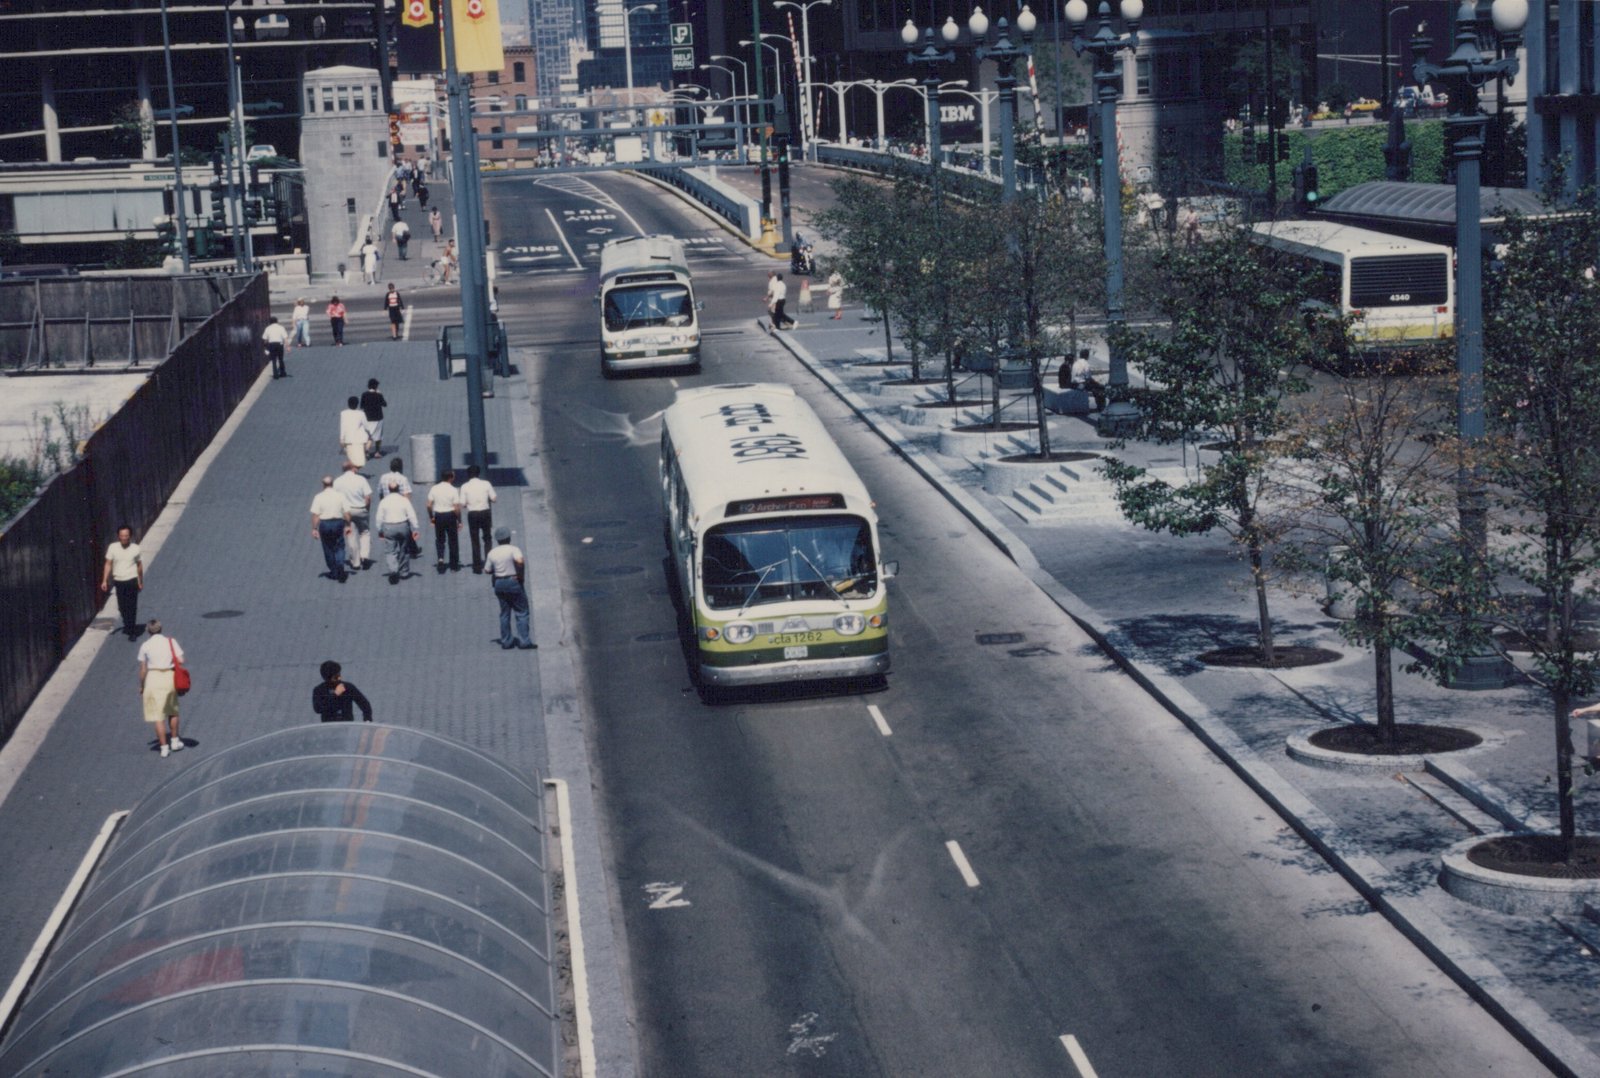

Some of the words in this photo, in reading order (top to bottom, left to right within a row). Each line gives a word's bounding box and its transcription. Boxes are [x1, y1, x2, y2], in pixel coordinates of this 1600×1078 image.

[940, 105, 975, 122] IBM
[563, 208, 608, 216] BUS
[503, 245, 560, 253] ONLY
[774, 633, 791, 645] cta
[794, 632, 823, 643] 1262
